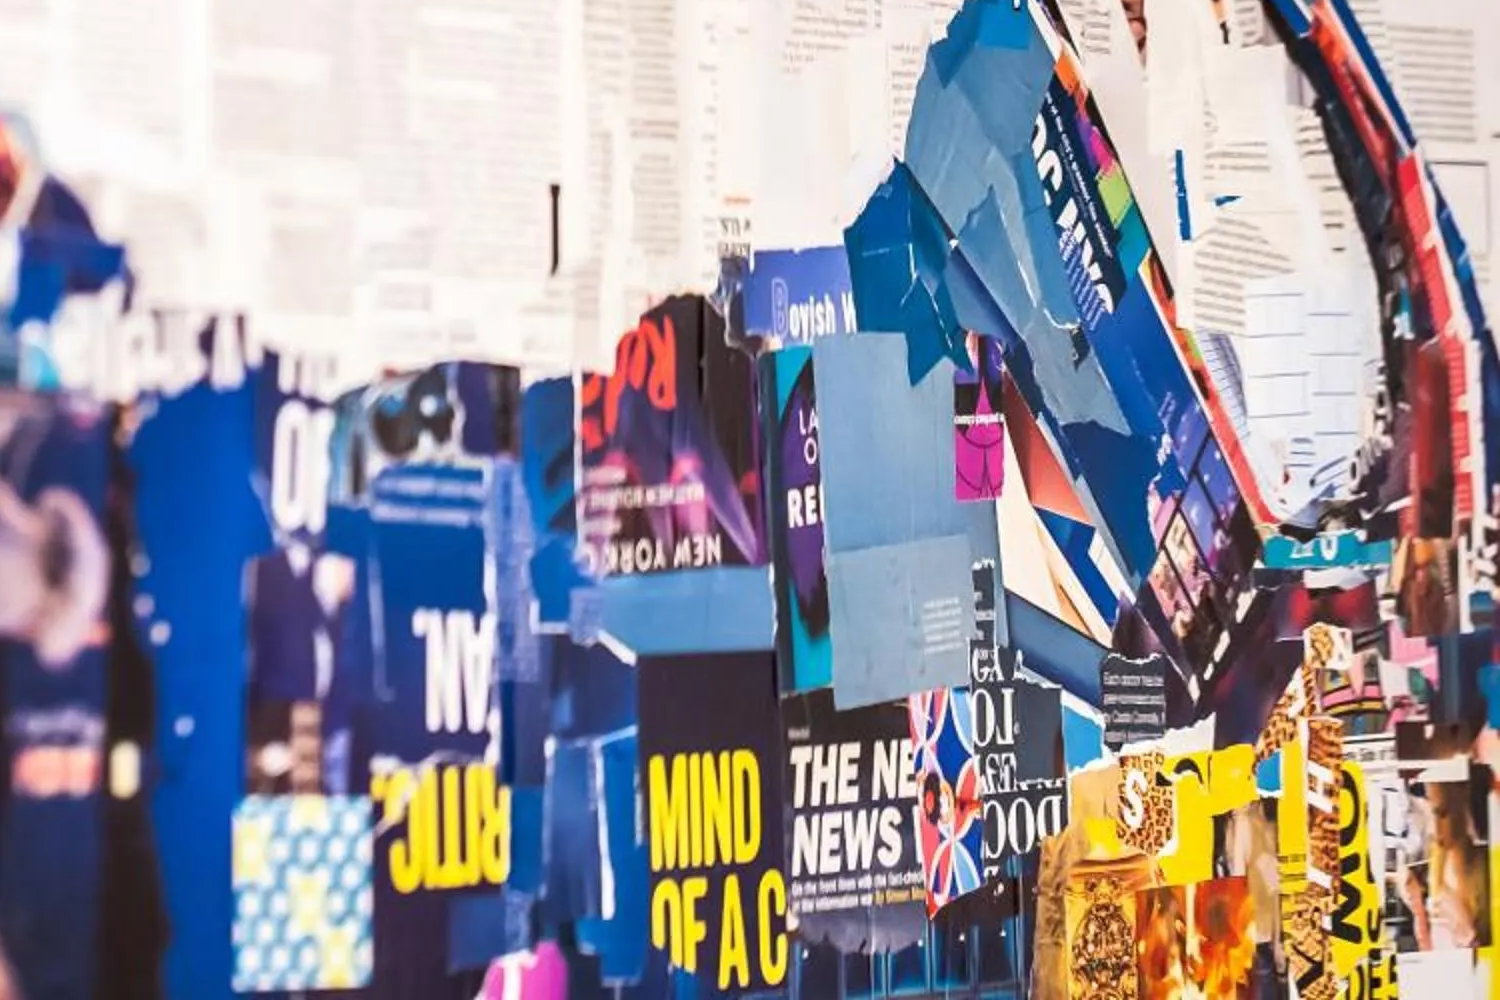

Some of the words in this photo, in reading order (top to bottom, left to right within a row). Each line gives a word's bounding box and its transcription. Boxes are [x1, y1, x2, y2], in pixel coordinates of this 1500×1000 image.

[787, 486, 824, 529] RE
[674, 533, 722, 568] NEW
[649, 748, 762, 872] MIND
[790, 743, 864, 809] THE
[791, 804, 903, 877] NEWS
[651, 876, 708, 974] OF
[718, 873, 749, 991] A
